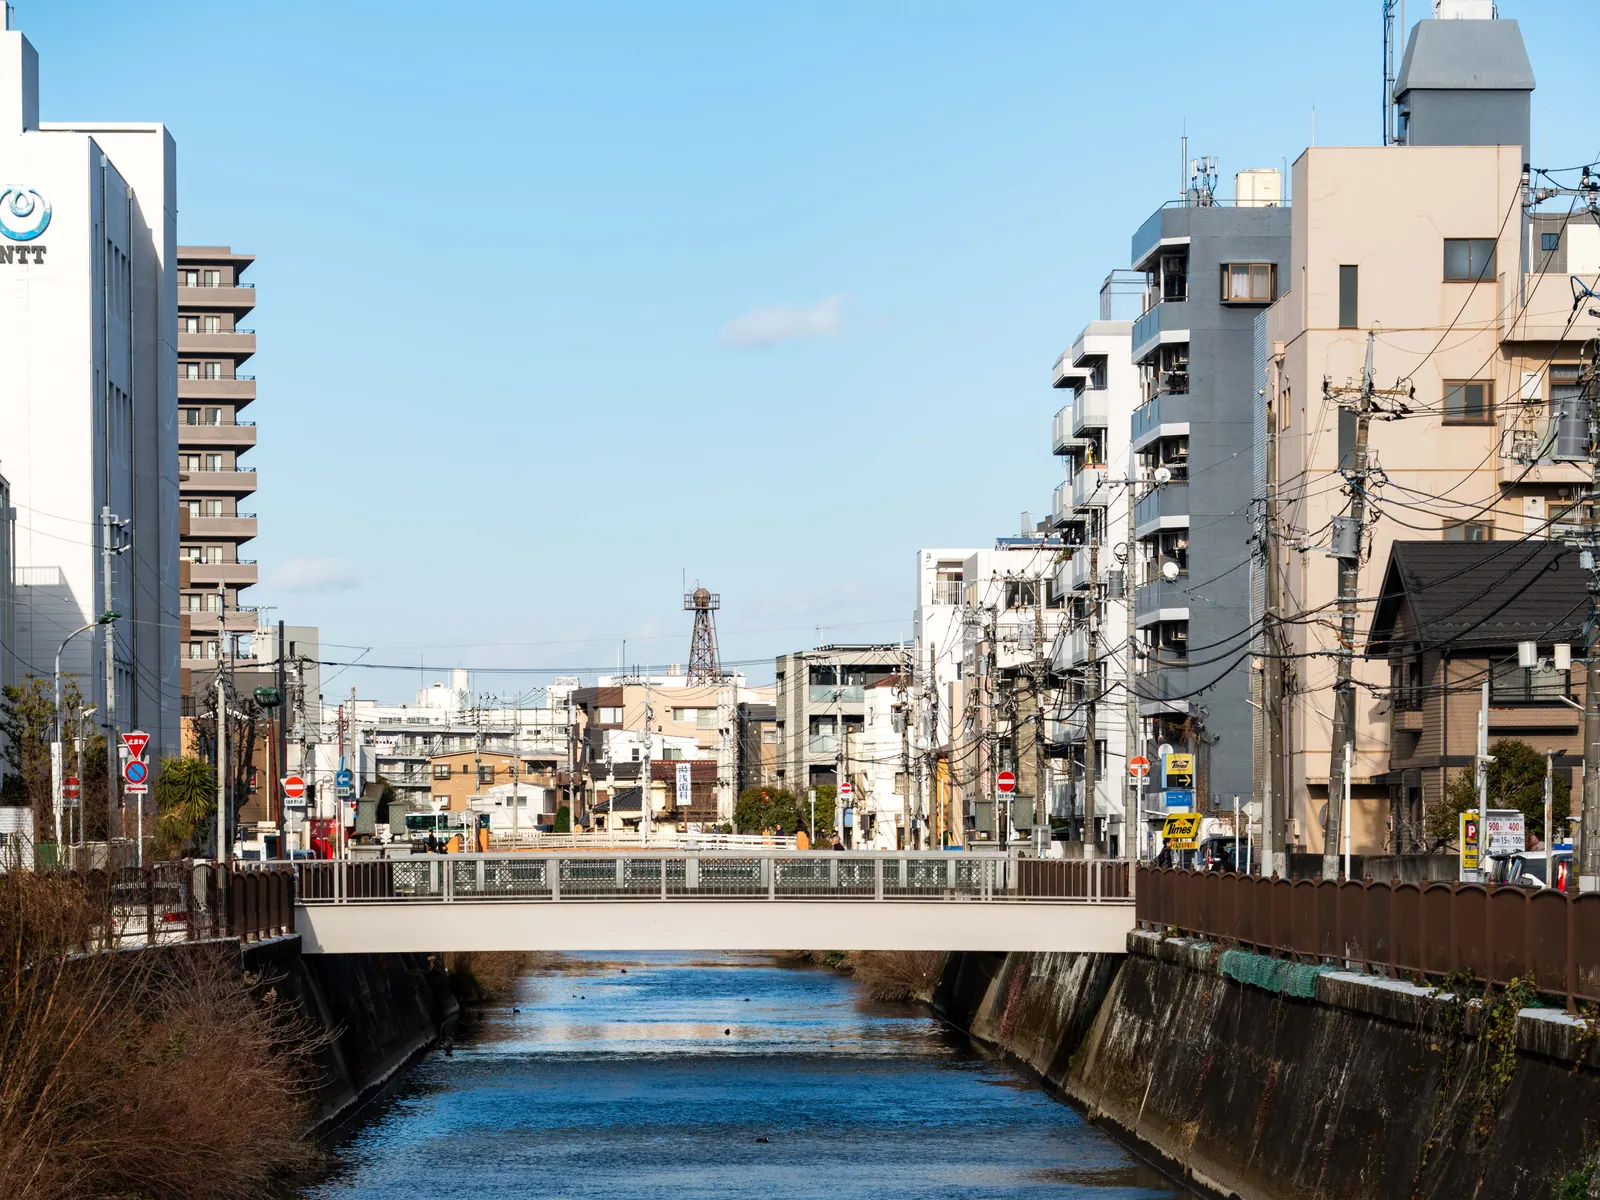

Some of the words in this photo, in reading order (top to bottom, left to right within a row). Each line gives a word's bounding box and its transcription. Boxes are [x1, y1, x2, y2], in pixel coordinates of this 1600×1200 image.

[0, 245, 47, 264] NTT
[1171, 760, 1189, 769] Times
[1166, 818, 1195, 835] Times
[1468, 825, 1476, 837] P
